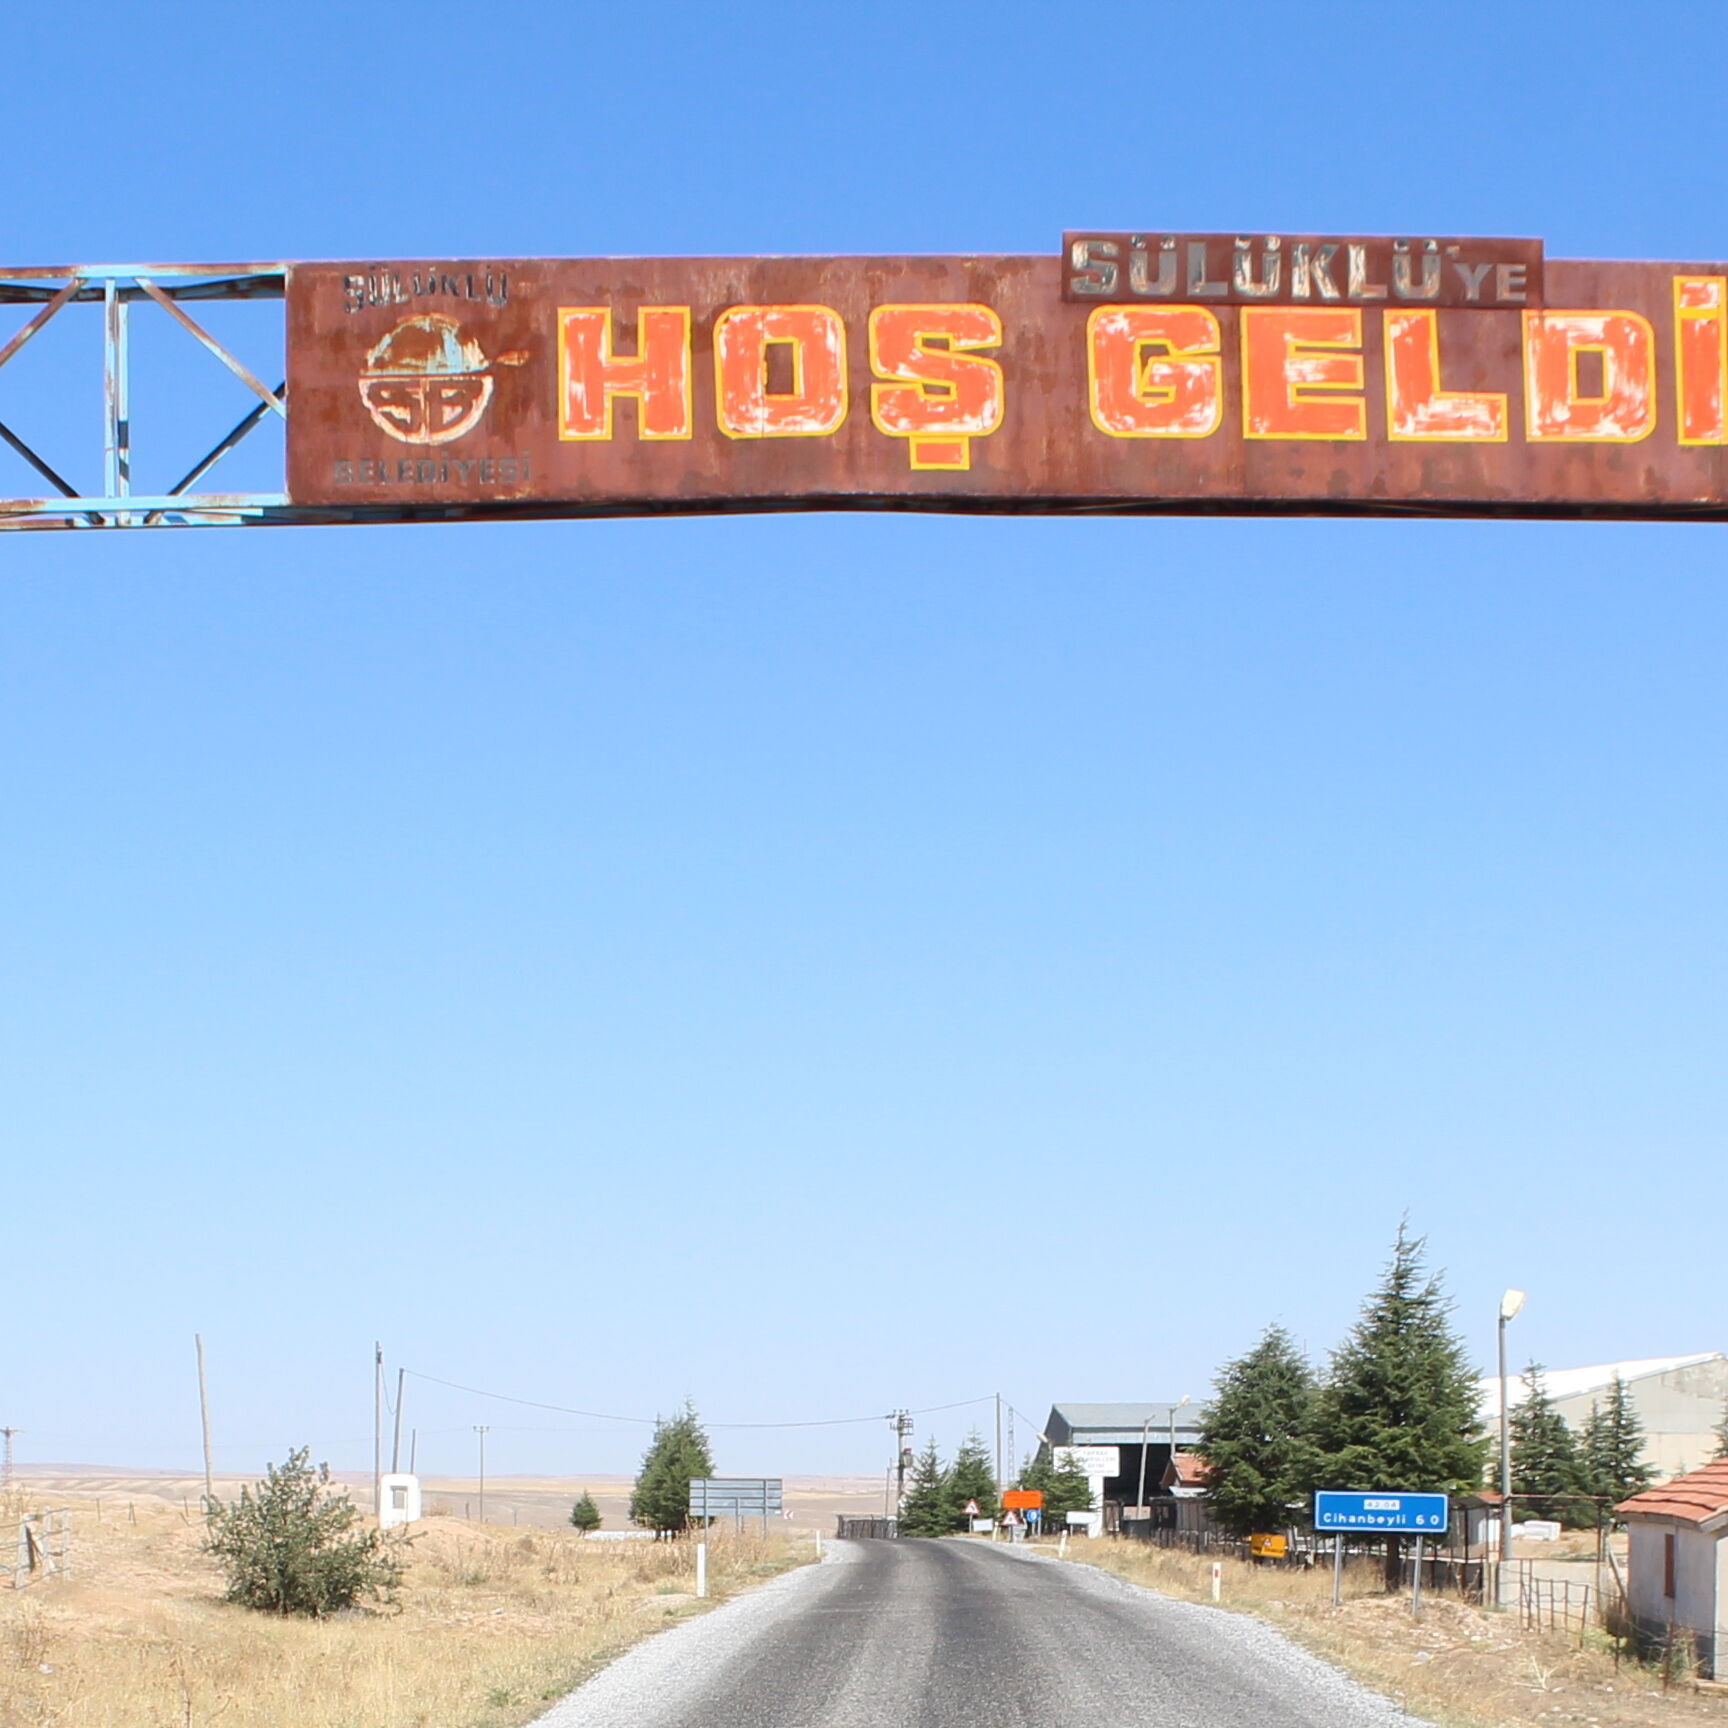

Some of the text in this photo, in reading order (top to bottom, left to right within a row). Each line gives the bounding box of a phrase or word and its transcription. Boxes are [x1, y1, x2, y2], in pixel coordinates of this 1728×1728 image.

[557, 303, 1005, 471] HOŞ
[333, 451, 531, 485] BELEDİYESİ
[1323, 1512, 1440, 1526] Cihanbeyli 60
